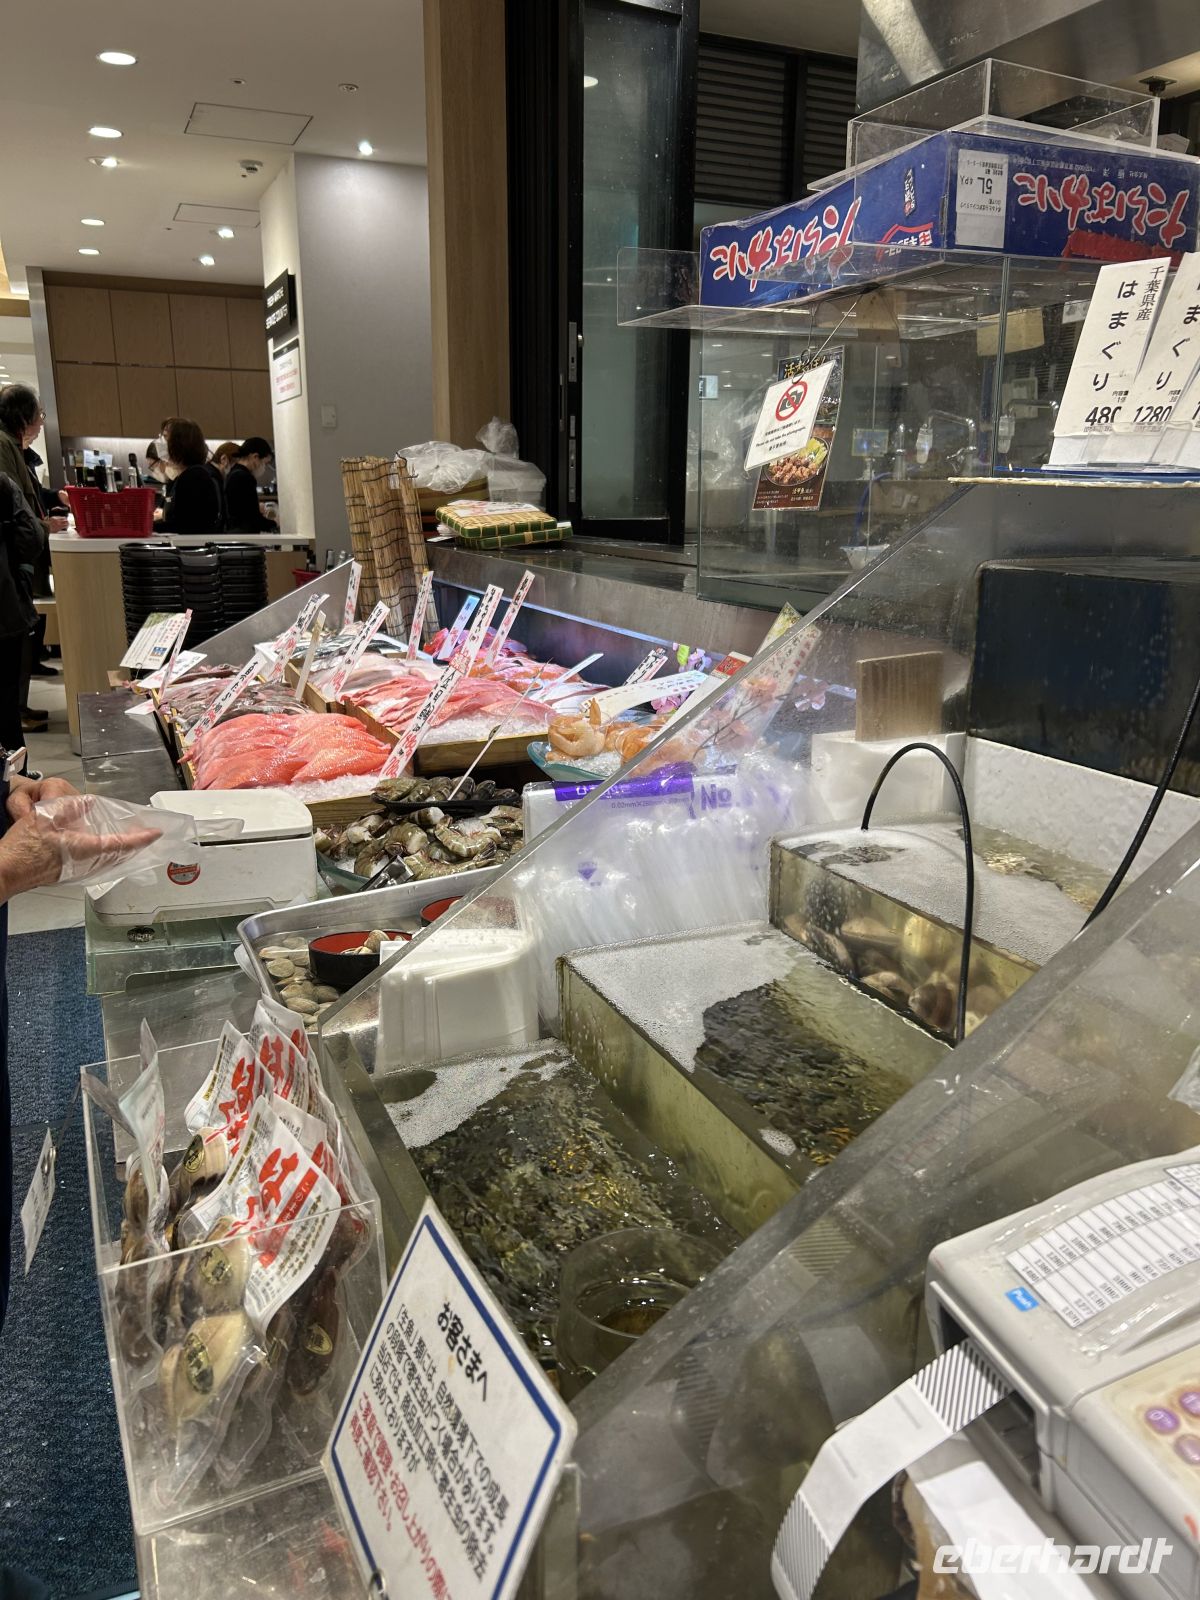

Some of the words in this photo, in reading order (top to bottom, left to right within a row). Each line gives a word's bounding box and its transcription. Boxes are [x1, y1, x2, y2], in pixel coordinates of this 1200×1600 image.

[976, 176, 993, 195] 5L
[1135, 265, 1166, 322] 千葉県産
[1092, 279, 1139, 392] はまぐり
[1155, 278, 1200, 391] まぐり
[1132, 405, 1173, 423] 1280
[1013, 1289, 1033, 1309] Push
[437, 1301, 488, 1402] お客さまへ
